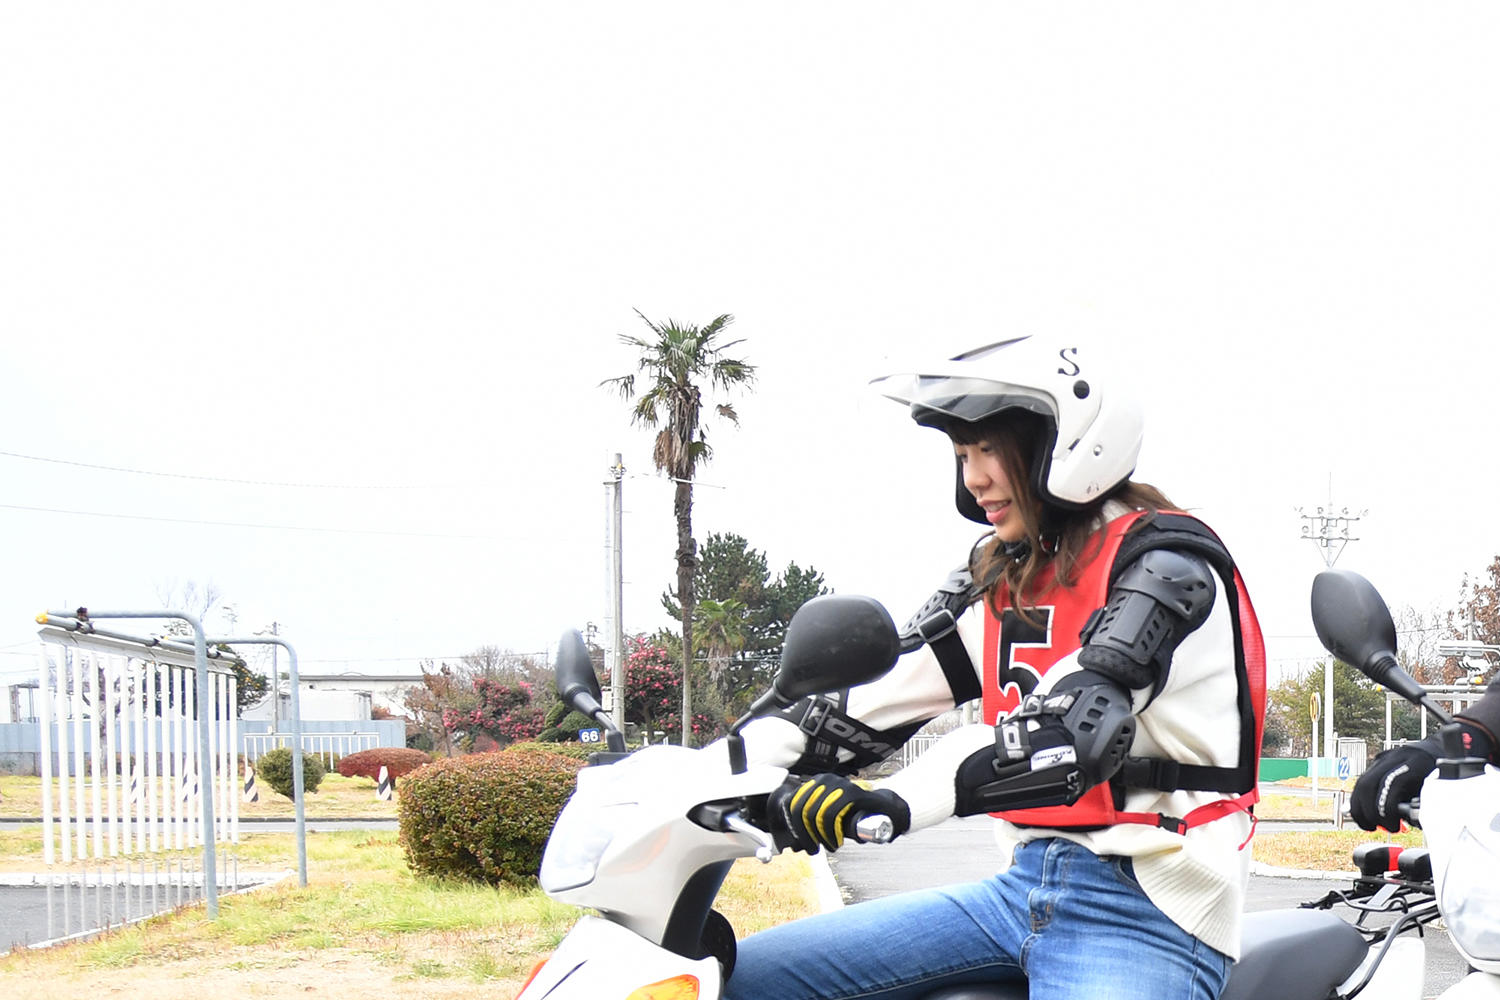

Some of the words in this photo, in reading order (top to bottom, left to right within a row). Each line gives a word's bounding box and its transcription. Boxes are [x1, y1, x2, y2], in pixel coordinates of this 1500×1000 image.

[1057, 347, 1081, 377] S
[997, 605, 1055, 724] 5
[581, 730, 599, 743] 66
